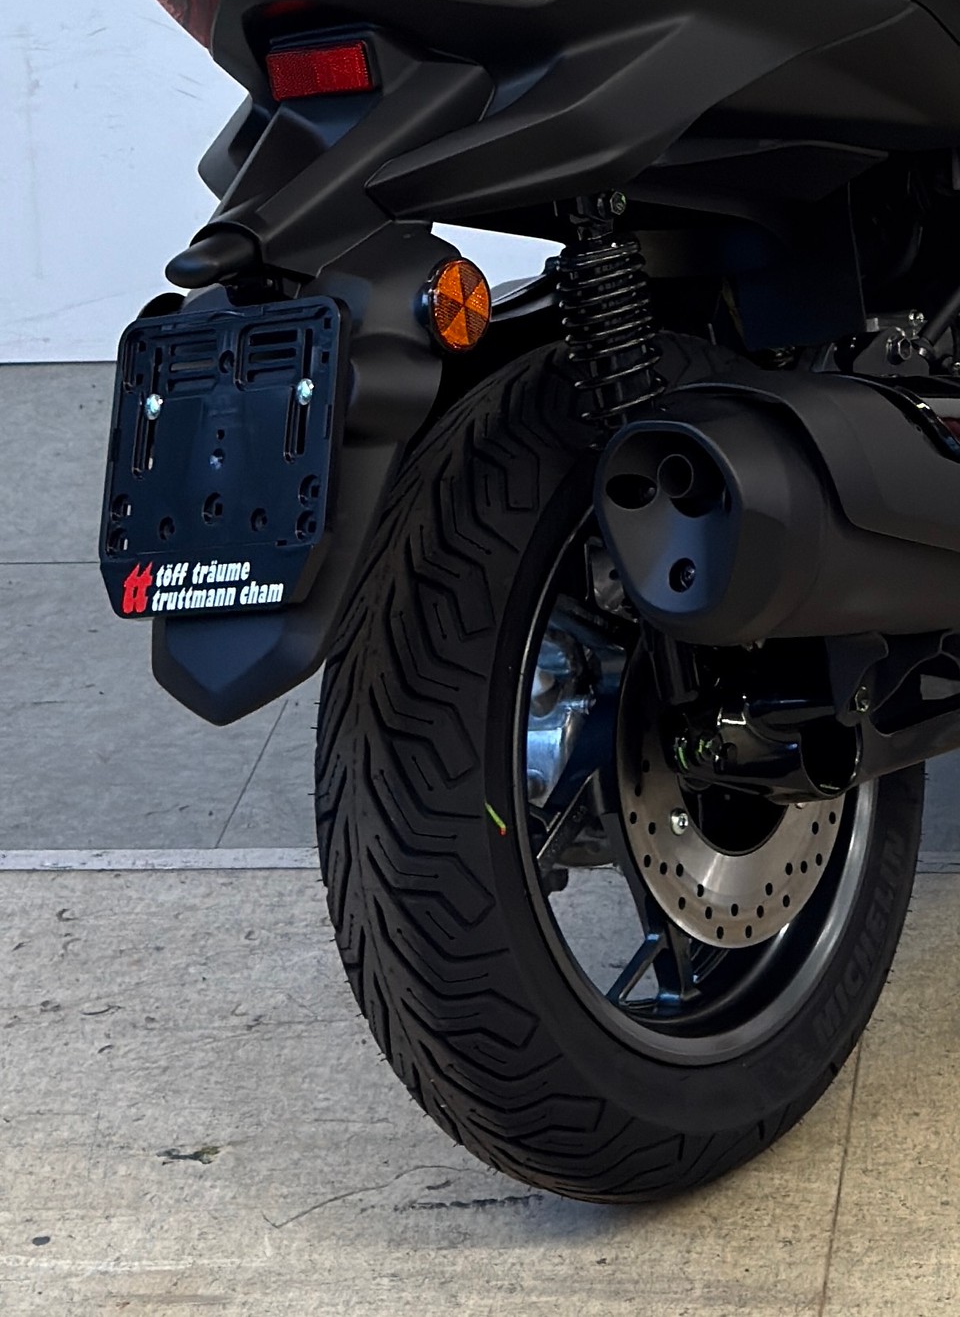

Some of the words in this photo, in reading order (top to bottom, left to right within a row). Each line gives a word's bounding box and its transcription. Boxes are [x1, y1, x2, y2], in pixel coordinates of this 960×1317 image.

[156, 562, 189, 587] töff
[192, 560, 250, 584] träume
[152, 587, 236, 611] truttmann
[240, 581, 284, 605] cham
